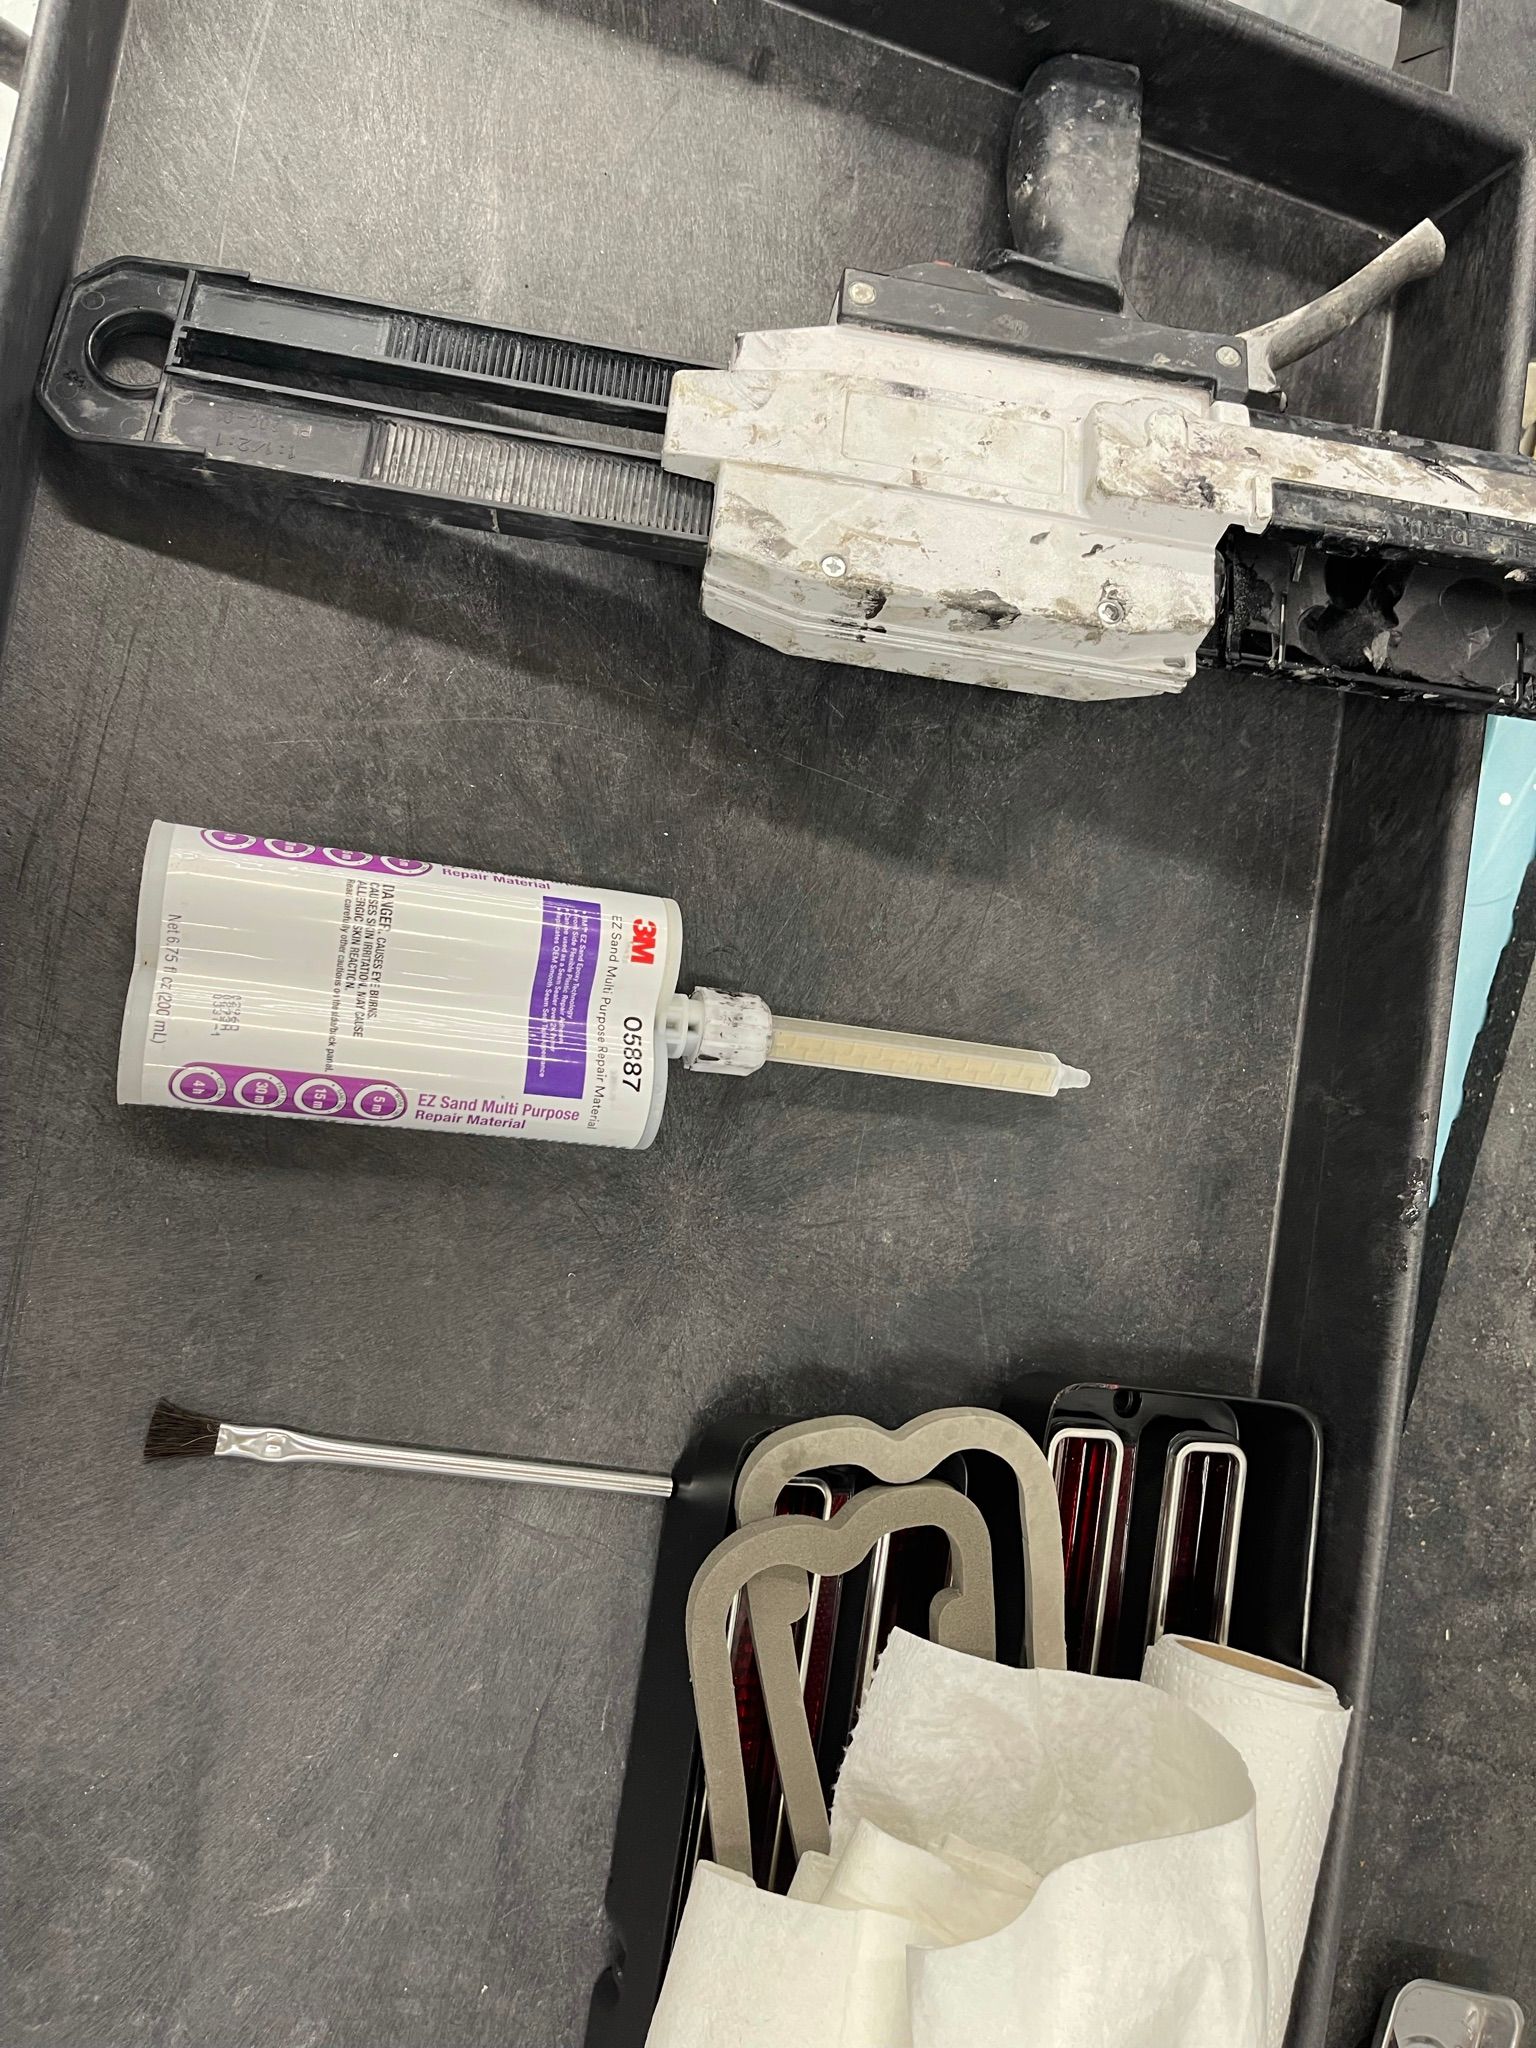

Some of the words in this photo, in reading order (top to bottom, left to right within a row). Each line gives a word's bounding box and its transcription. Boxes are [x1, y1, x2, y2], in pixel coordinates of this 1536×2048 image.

[442, 868, 488, 881] Repair
[493, 875, 550, 890] Material
[354, 880, 367, 922] ALLERGIC
[367, 882, 379, 915] CAUSES
[166, 914, 182, 935] Net
[612, 915, 622, 930] EZ
[339, 934, 348, 953] other
[352, 925, 362, 945] SKIN
[571, 931, 579, 946] Side
[630, 919, 657, 965] 3M
[165, 936, 180, 962] 6.75
[373, 937, 386, 969] CAUSES
[551, 945, 559, 963] OEM
[578, 944, 586, 962] Sand
[609, 932, 622, 962] Sand
[358, 941, 373, 989] IRRITATION.
[567, 947, 577, 973] Flexible
[547, 964, 556, 988] Smooth
[556, 968, 564, 985] Seam
[562, 973, 572, 993] Plastic
[573, 963, 583, 982] Epoxy
[603, 966, 618, 994] Multi
[156, 992, 172, 1016] (200
[542, 988, 552, 1007] Seam
[551, 986, 561, 1006] Sealer
[559, 994, 568, 1016] Repair
[567, 983, 579, 1020] Technology
[596, 997, 611, 1043] Purpose
[150, 1020, 167, 1044] mL)
[596, 1046, 608, 1082] Repair
[622, 1016, 643, 1093] 05887
[255, 1081, 268, 1094] 30
[314, 1088, 327, 1100] 15
[254, 1095, 265, 1103] m
[312, 1101, 323, 1109] m
[371, 1104, 381, 1112] m
[418, 1093, 437, 1108] EZ
[440, 1095, 477, 1111] Sand
[481, 1099, 518, 1115] Multi
[522, 1104, 580, 1121] Purpose
[587, 1085, 606, 1130] Material
[415, 1110, 463, 1124] Repair
[467, 1115, 527, 1129] Material
